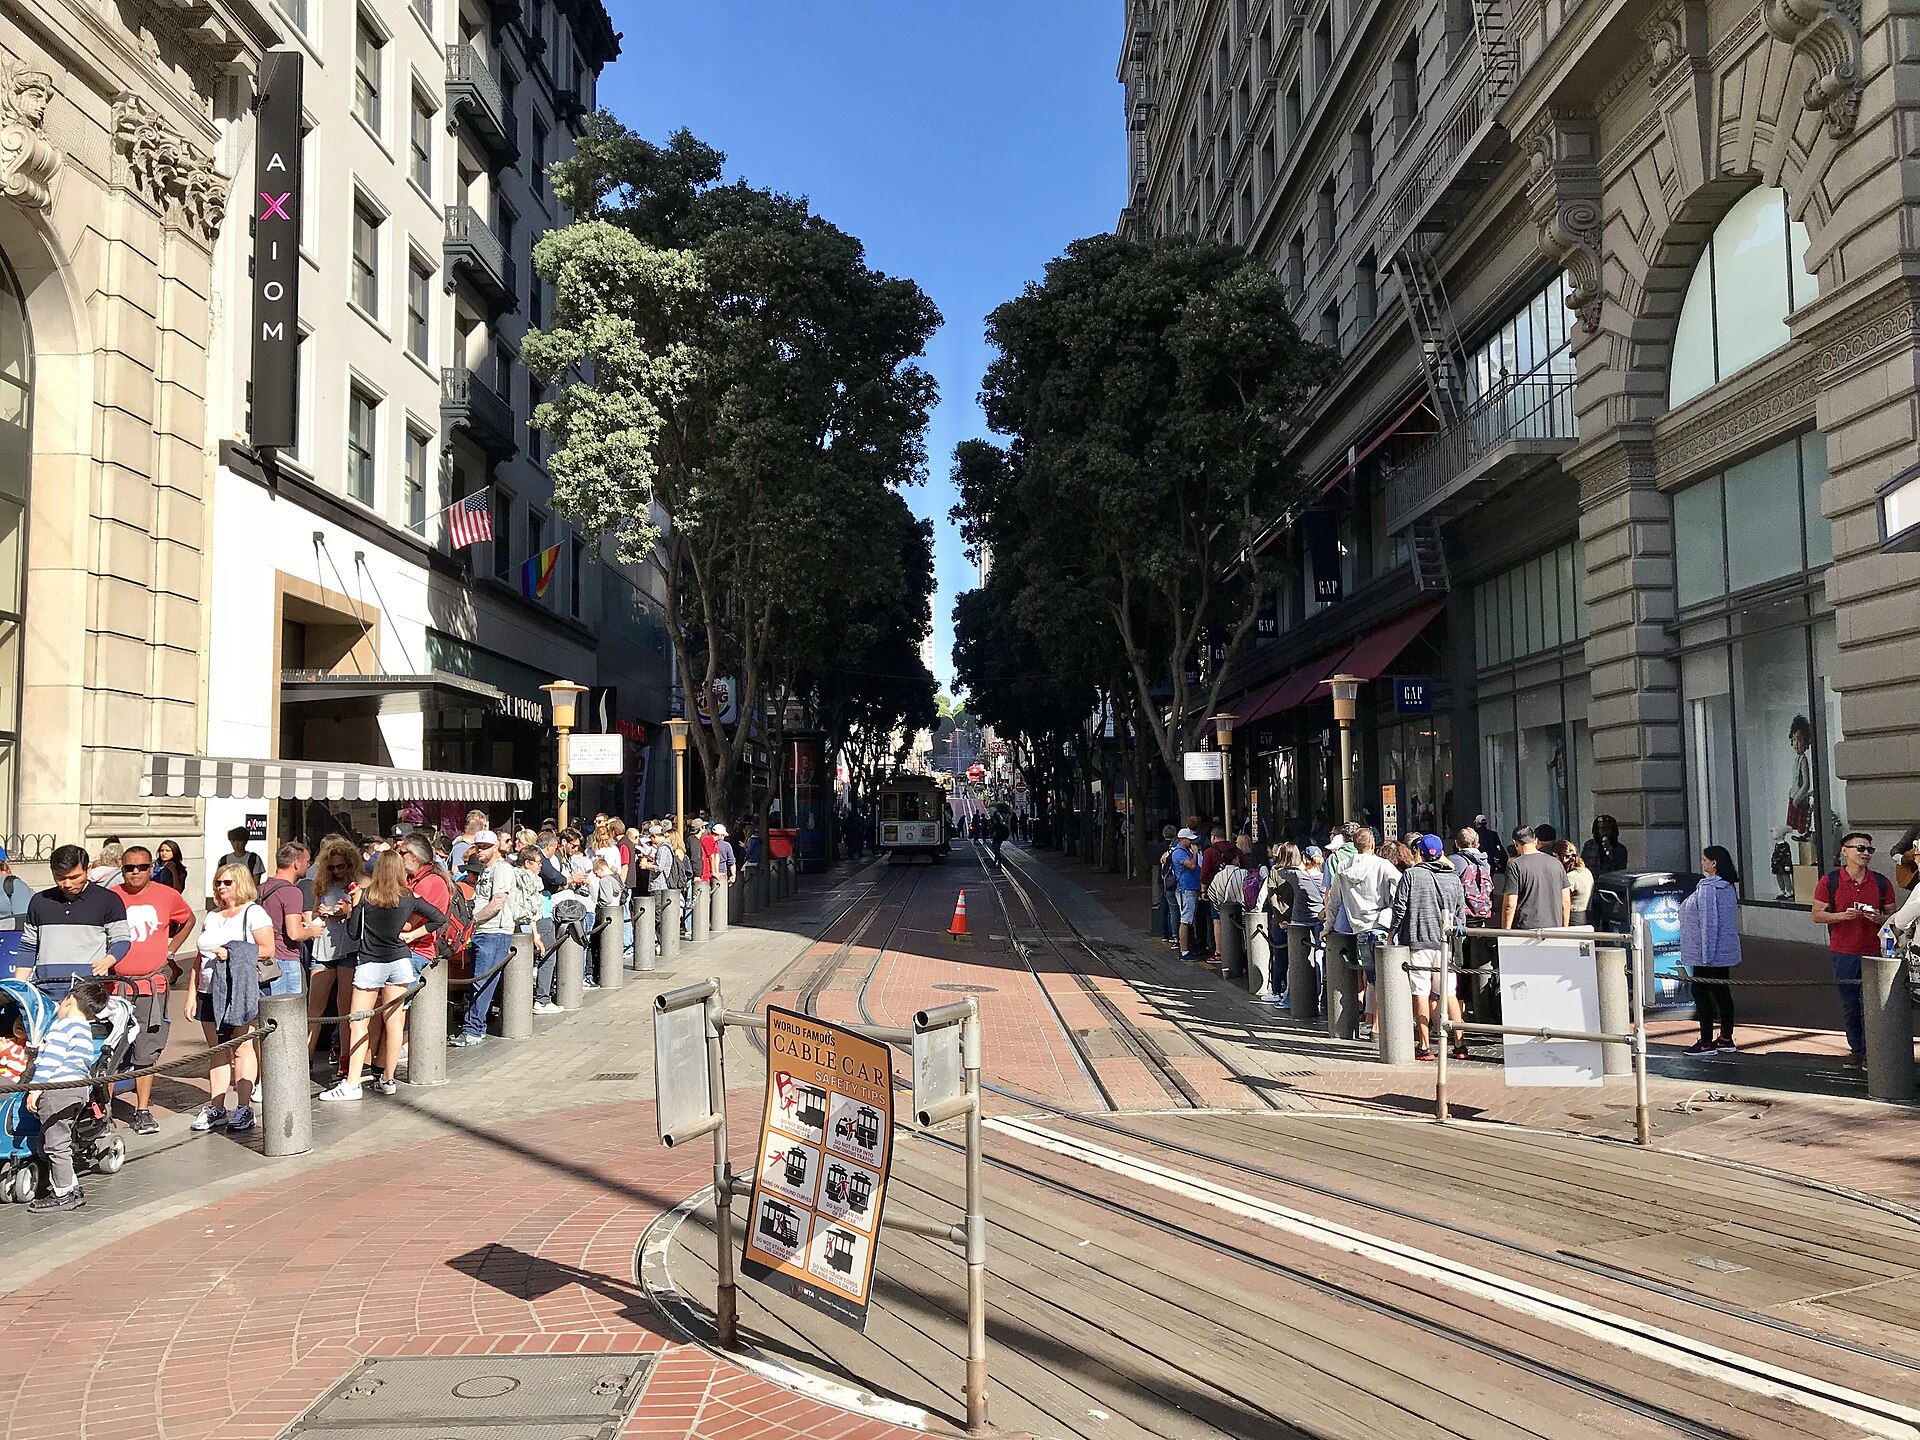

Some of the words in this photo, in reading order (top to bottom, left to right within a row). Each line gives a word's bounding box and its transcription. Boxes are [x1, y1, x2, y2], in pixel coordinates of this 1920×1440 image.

[259, 152, 292, 342] AXIOM
[1319, 580, 1337, 594] GAP
[1258, 619, 1274, 631] GAP
[1215, 648, 1225, 659] GA
[1404, 686, 1423, 700] GAP
[500, 694, 543, 725] SEPHORA
[1644, 912, 1668, 920] UNION
[773, 1018, 801, 1036] WORLD
[802, 1027, 836, 1047] FAMOUS
[773, 1034, 838, 1071] CABLE
[841, 1056, 886, 1089] CAR
[815, 1070, 859, 1094] SAFETY
[860, 1084, 886, 1105] TIPS
